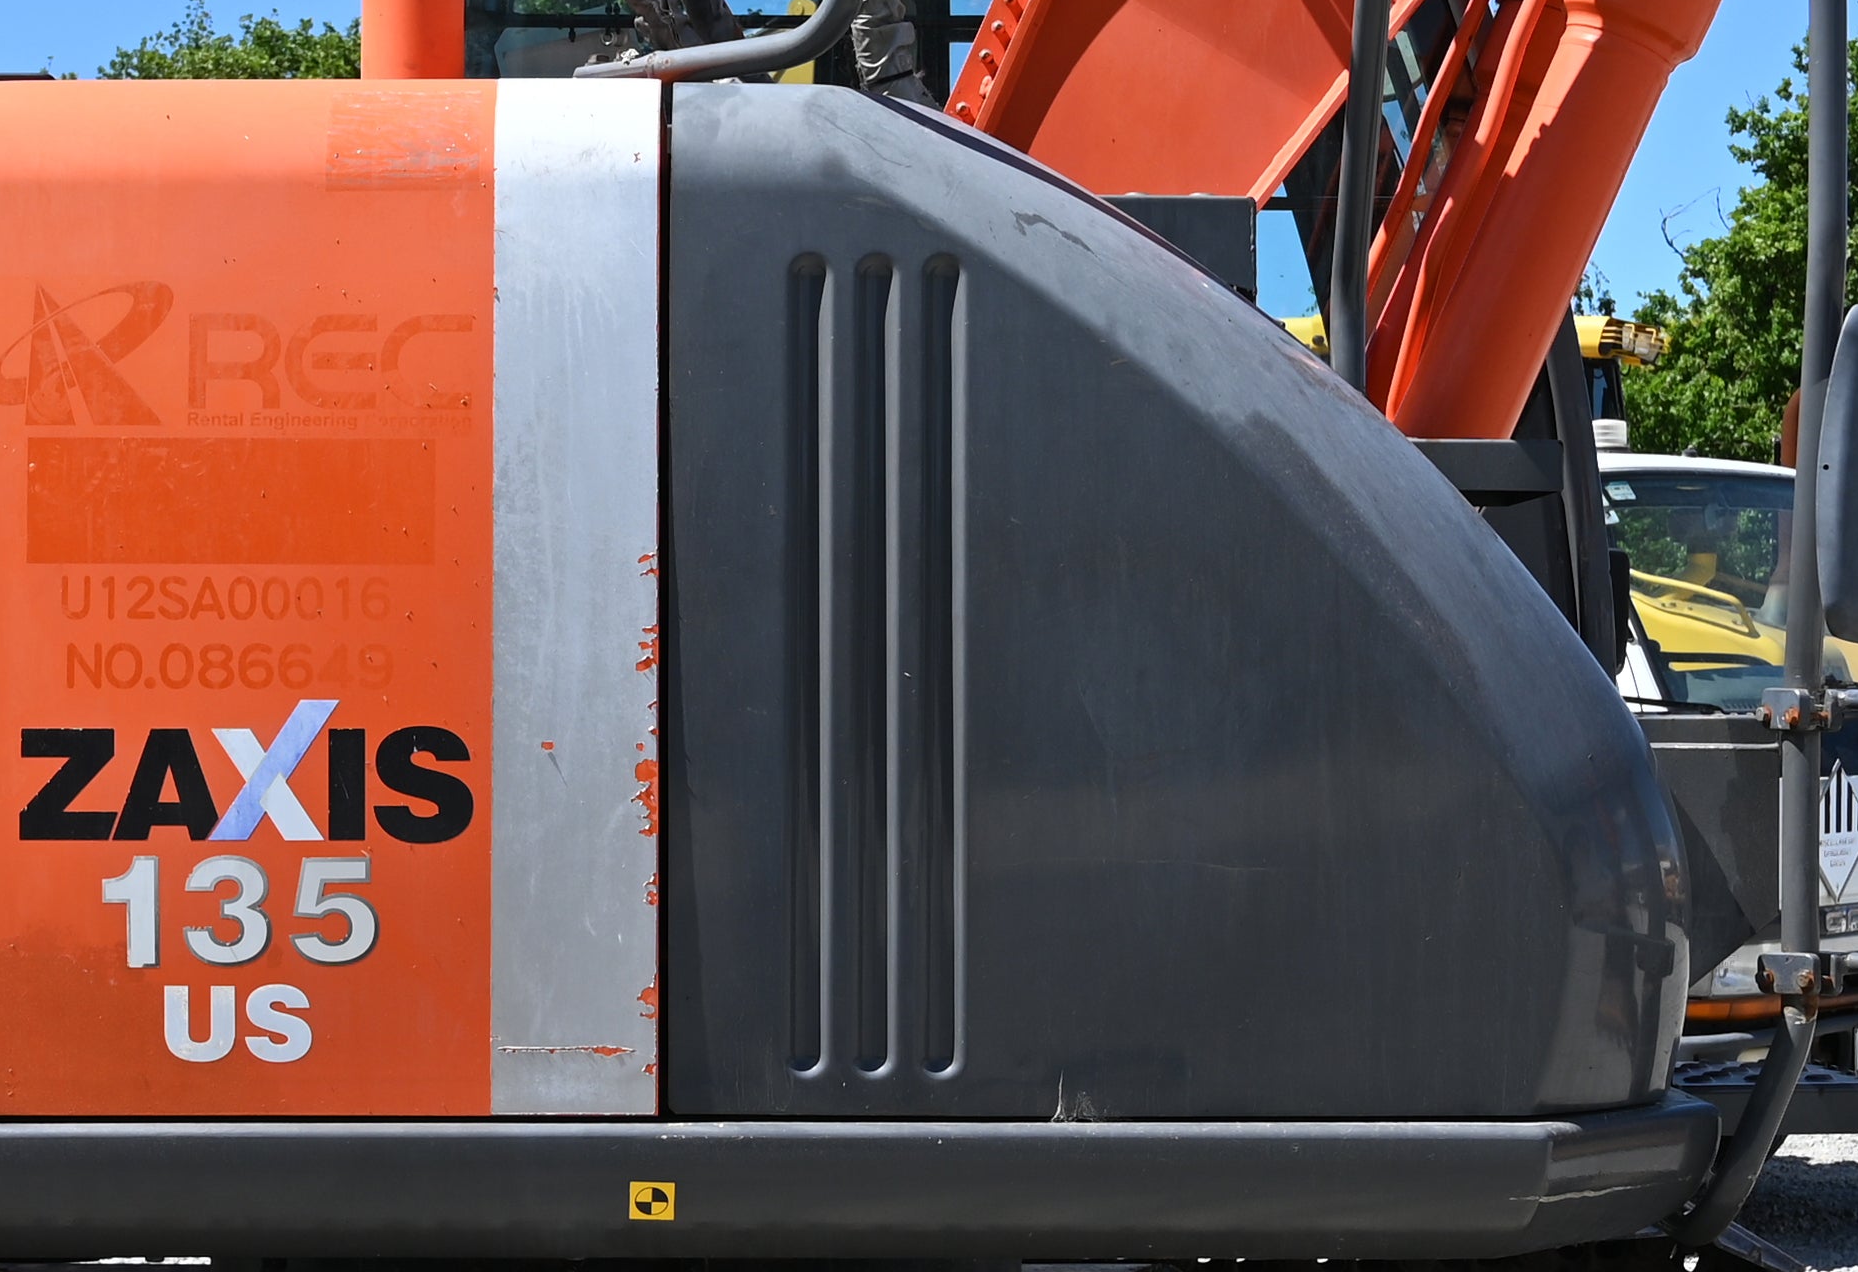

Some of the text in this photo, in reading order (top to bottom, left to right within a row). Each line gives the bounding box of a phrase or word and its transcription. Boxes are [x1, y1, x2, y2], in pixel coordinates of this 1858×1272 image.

[187, 312, 474, 410] REC
[186, 411, 243, 427] Rental
[250, 411, 359, 430] Engineering
[60, 575, 391, 621] U12SA00016
[19, 699, 475, 844] ZAXIS
[101, 855, 380, 968] 135
[163, 984, 313, 1063] US
